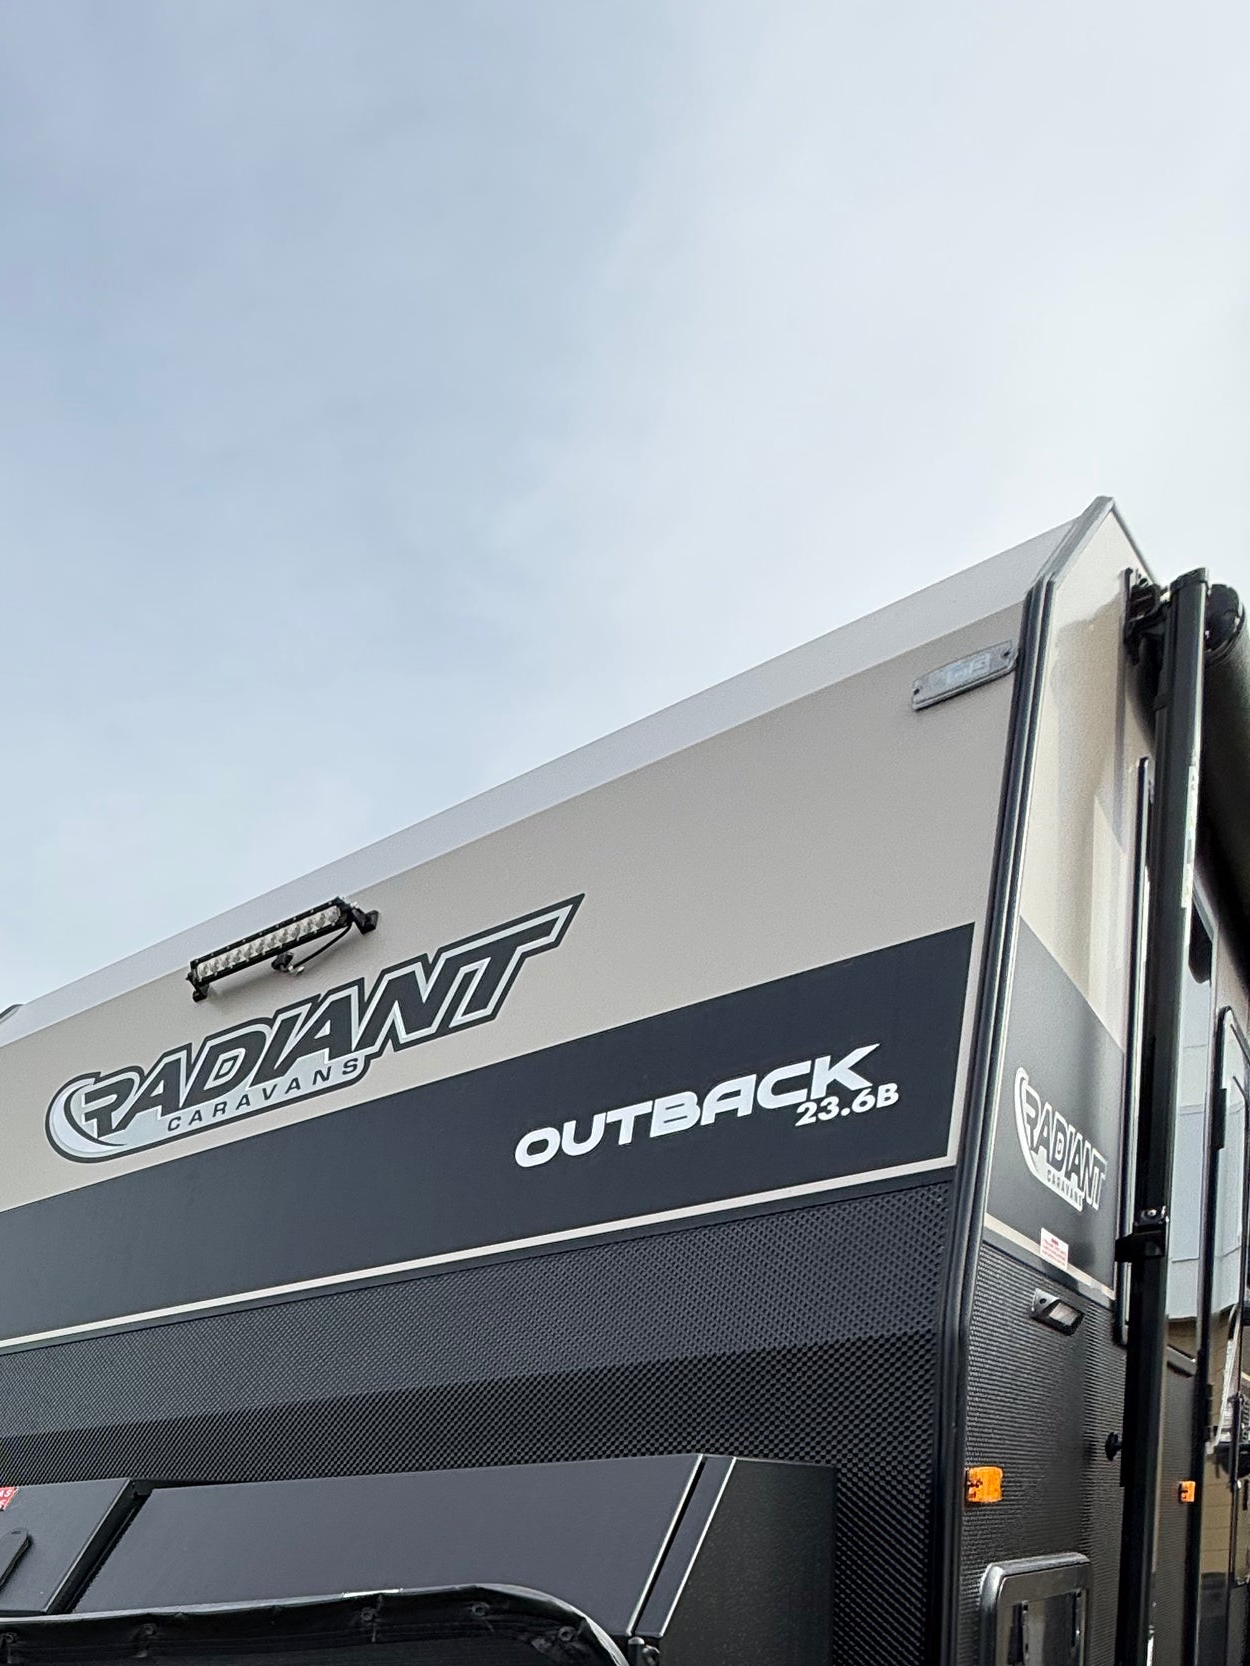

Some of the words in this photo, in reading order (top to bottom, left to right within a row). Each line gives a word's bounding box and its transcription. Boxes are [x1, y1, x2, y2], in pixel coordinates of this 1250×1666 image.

[76, 893, 585, 1140] RADIANT
[167, 1057, 359, 1133] CARAVANS
[515, 1043, 881, 1168] OUTBACK
[795, 1082, 900, 1127] 23.6B
[1020, 1080, 1109, 1211] RADIANT
